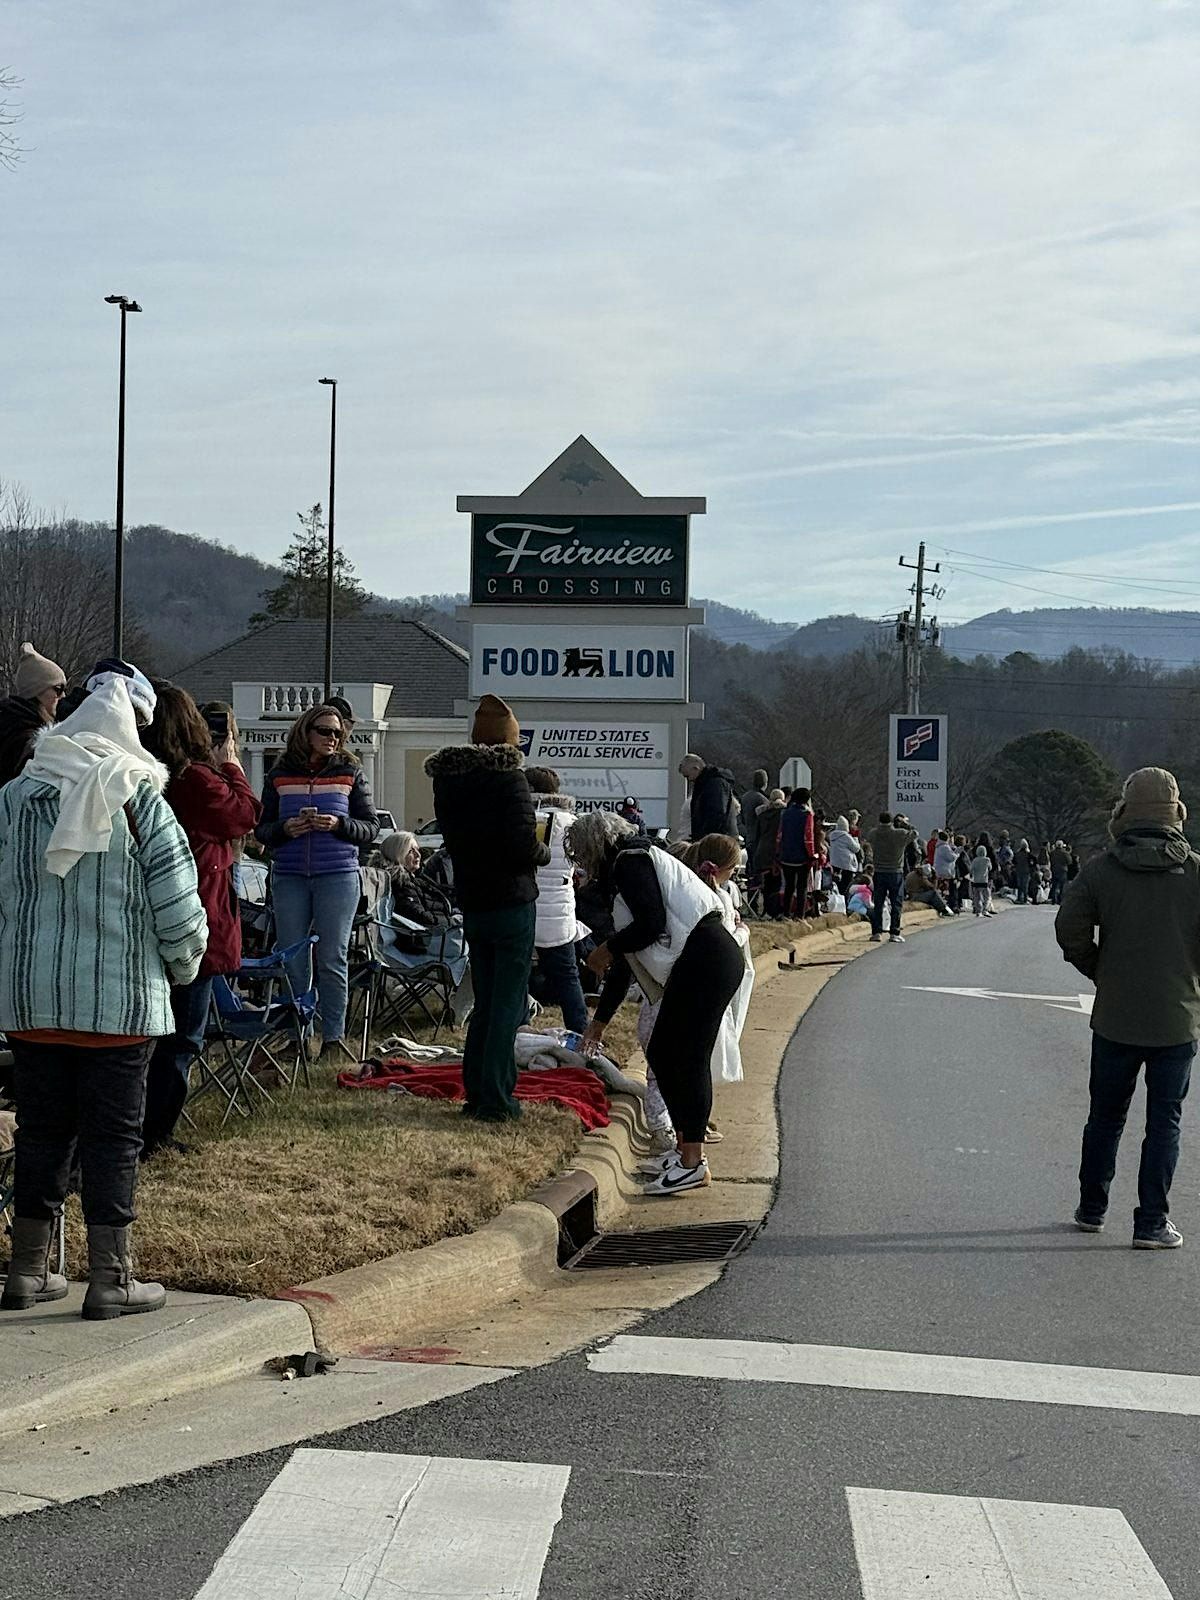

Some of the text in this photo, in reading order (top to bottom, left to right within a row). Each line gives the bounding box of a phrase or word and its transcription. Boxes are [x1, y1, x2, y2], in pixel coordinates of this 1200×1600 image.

[485, 522, 674, 574] Fairview
[487, 578, 671, 595] CROSSING
[482, 647, 674, 678] FOOD LION
[245, 731, 279, 743] FIRST
[346, 734, 373, 744] ANK
[542, 729, 650, 742] UNITED STATES
[538, 746, 654, 759] POSTAL SERVICE
[896, 767, 921, 777] First
[895, 779, 940, 790] Citizens
[896, 792, 925, 802] Bank
